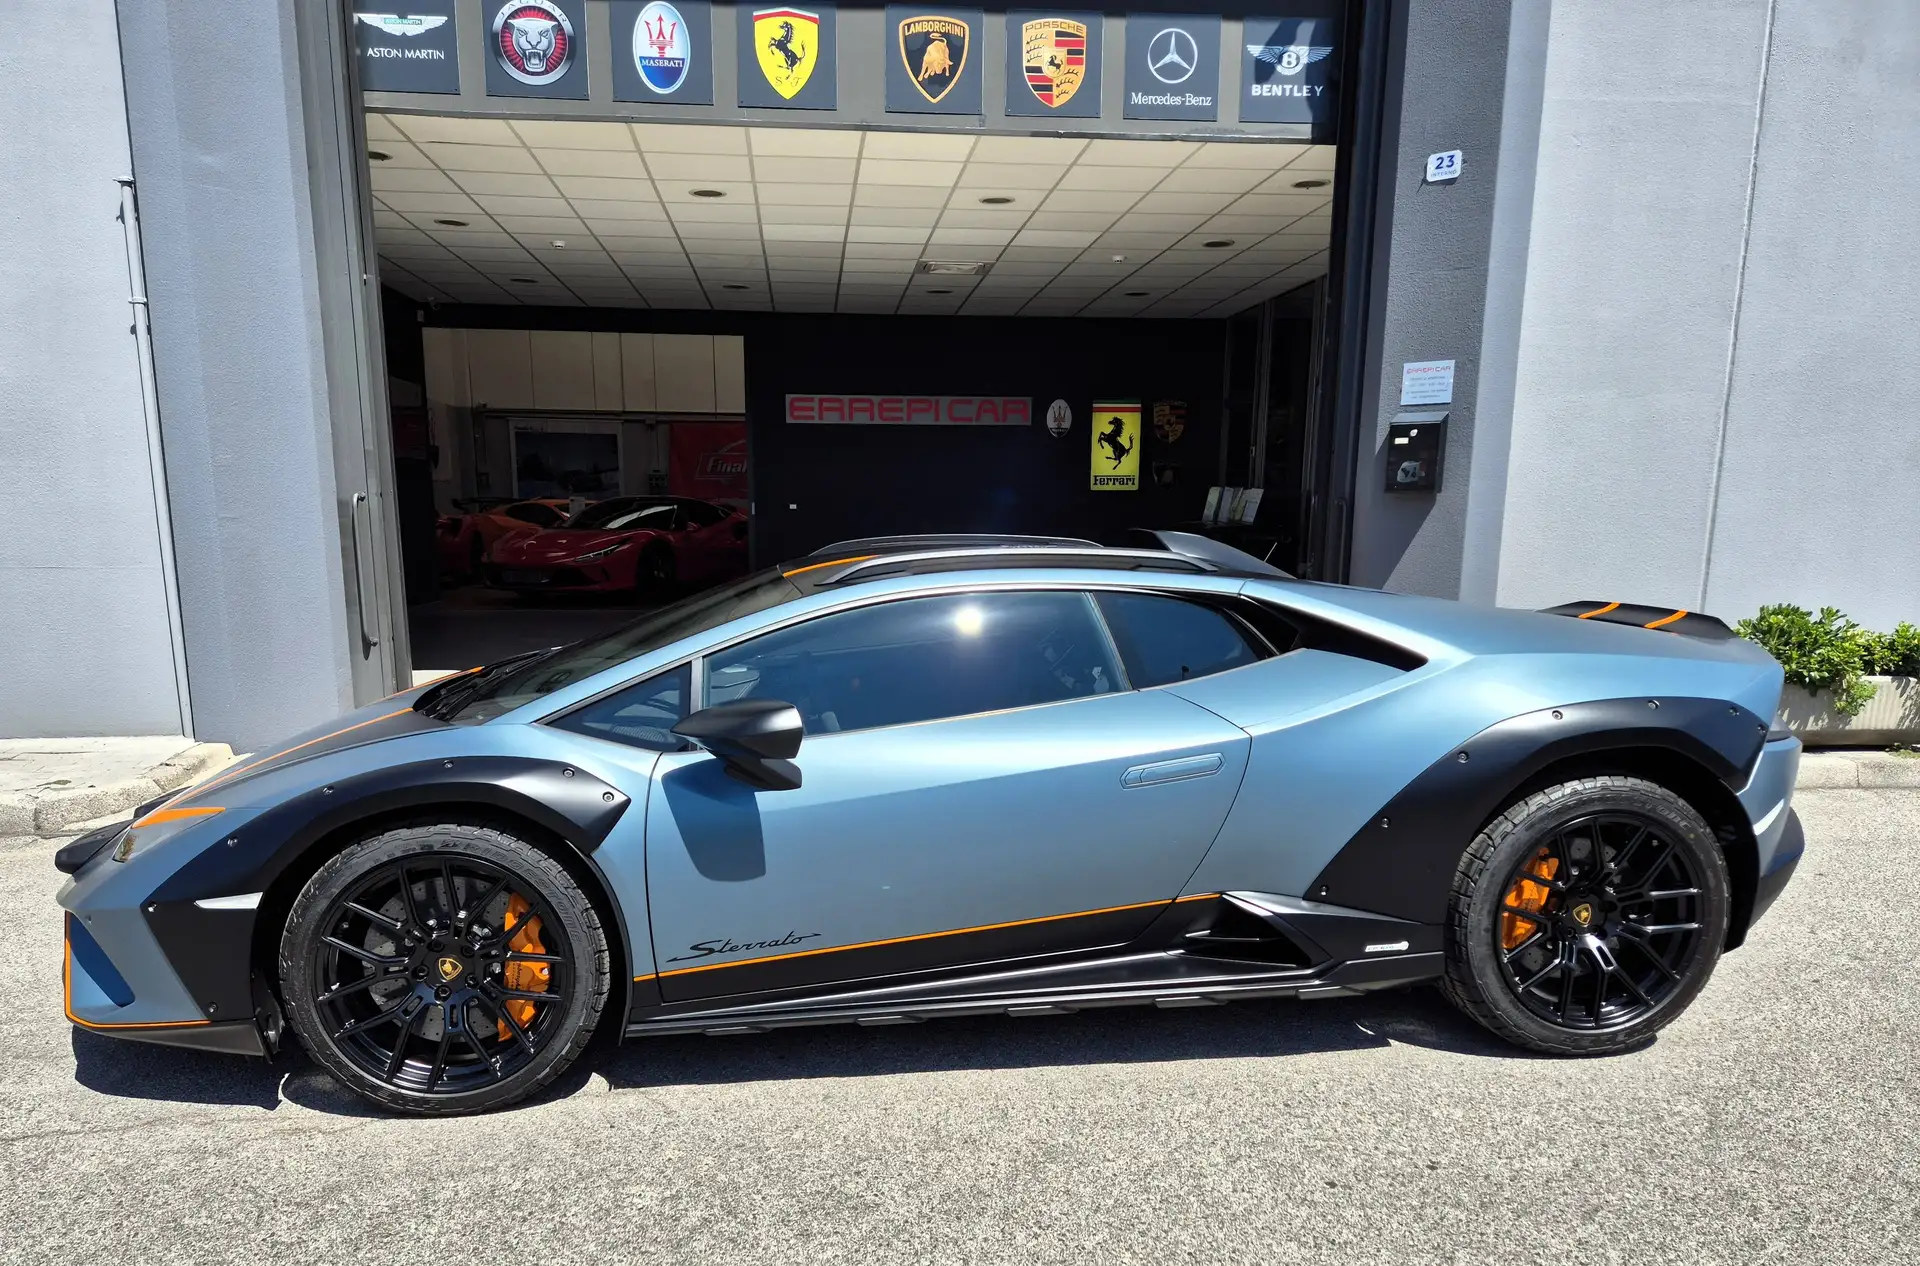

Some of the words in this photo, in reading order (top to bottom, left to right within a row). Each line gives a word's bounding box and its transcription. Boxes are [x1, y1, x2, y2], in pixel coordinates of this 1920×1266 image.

[402, 18, 422, 26] MARTIN
[1024, 19, 1085, 34] PORSCHE
[904, 22, 965, 38] LAMBORGHINI
[366, 47, 402, 59] ASTON
[404, 49, 445, 60] MARTIN
[1282, 52, 1297, 68] B
[641, 58, 684, 68] MASERATI
[1250, 83, 1324, 98] BENTLEY
[1130, 92, 1213, 107] Mercedes-Benz
[1434, 154, 1456, 170] 23
[1430, 169, 1457, 178] INTERNO
[1092, 474, 1136, 487] Ferrari
[437, 837, 582, 943] BRIDGESTONE
[667, 930, 821, 963] Sterrato
